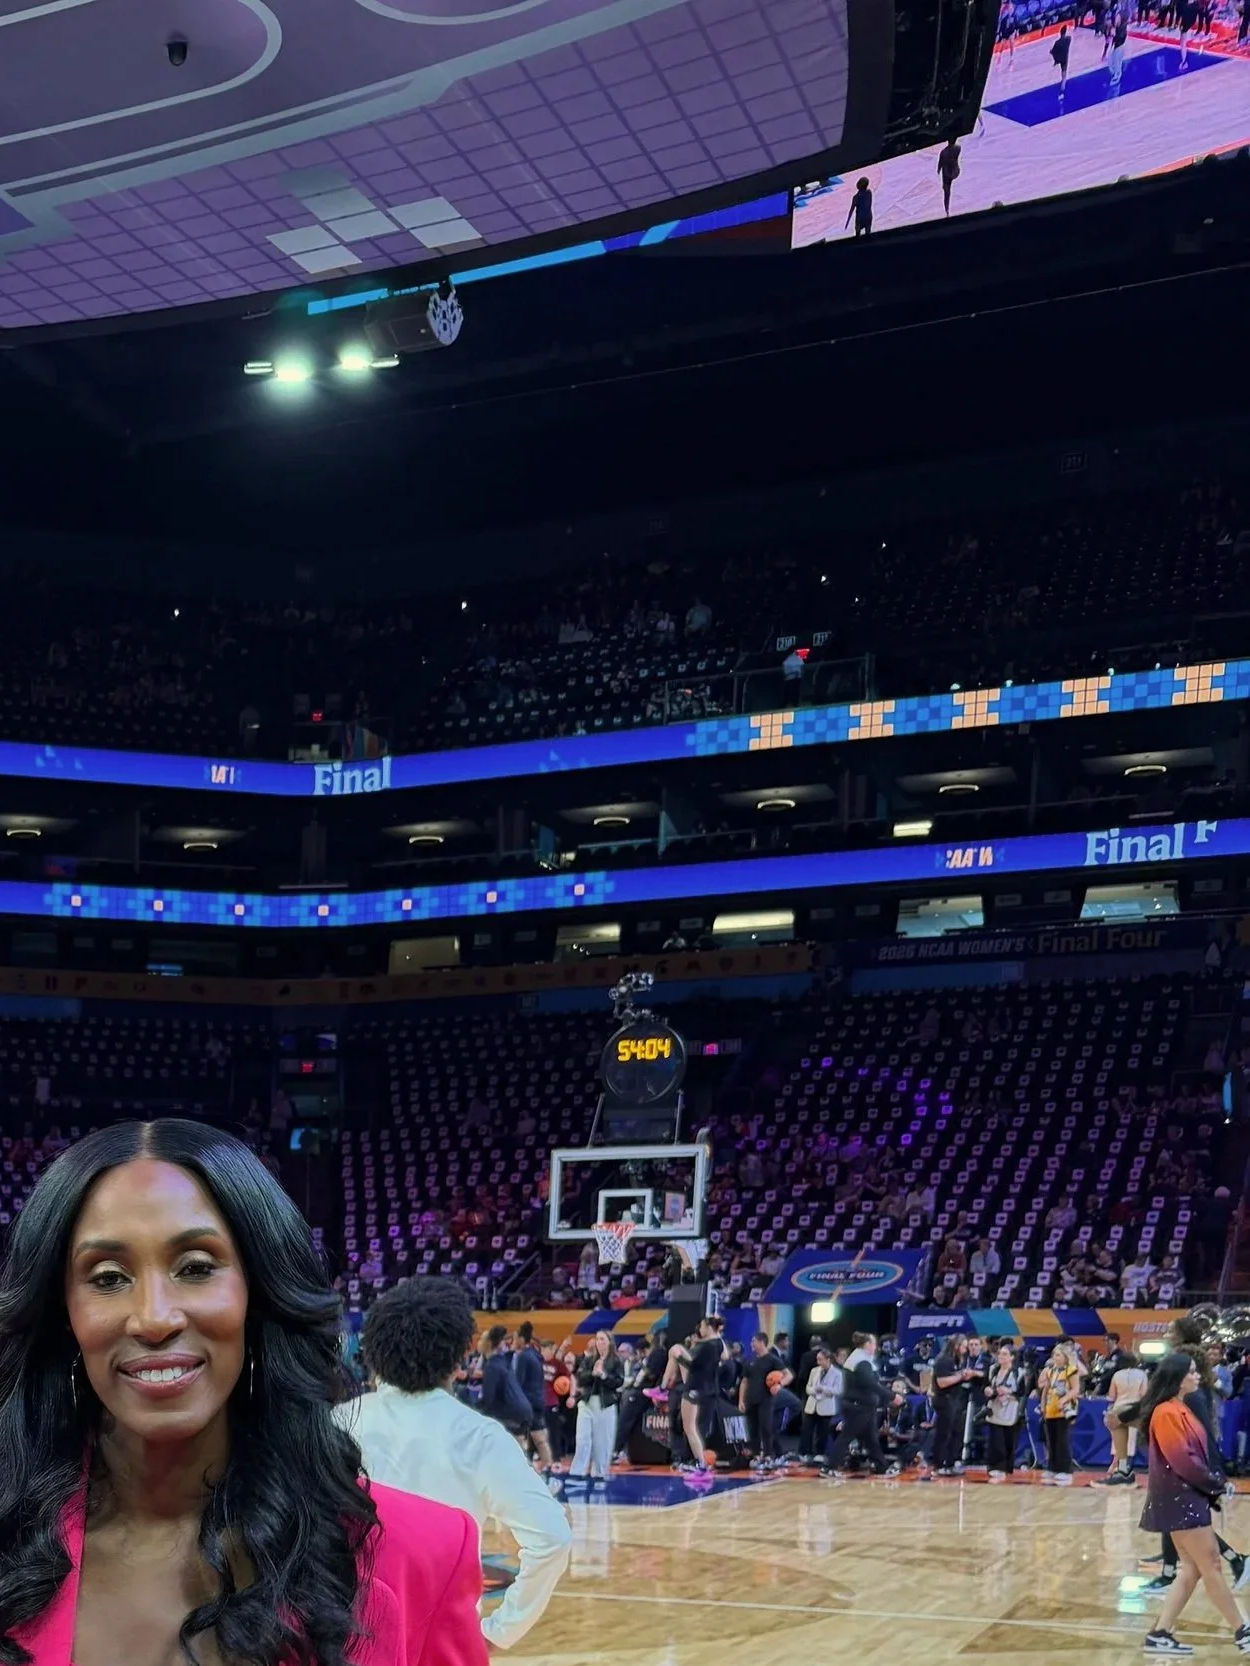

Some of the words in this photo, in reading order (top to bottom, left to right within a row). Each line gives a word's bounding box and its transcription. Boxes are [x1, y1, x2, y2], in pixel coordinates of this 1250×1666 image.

[313, 756, 392, 796] Final
[1083, 821, 1185, 866] Final
[877, 944, 916, 962] 2026
[918, 941, 955, 959] NCAA
[957, 935, 1028, 956] WOMEN'S
[1034, 928, 1099, 955] Final
[1105, 927, 1170, 950] Four
[617, 1037, 672, 1062] 54:04
[908, 1314, 966, 1329] ESPN
